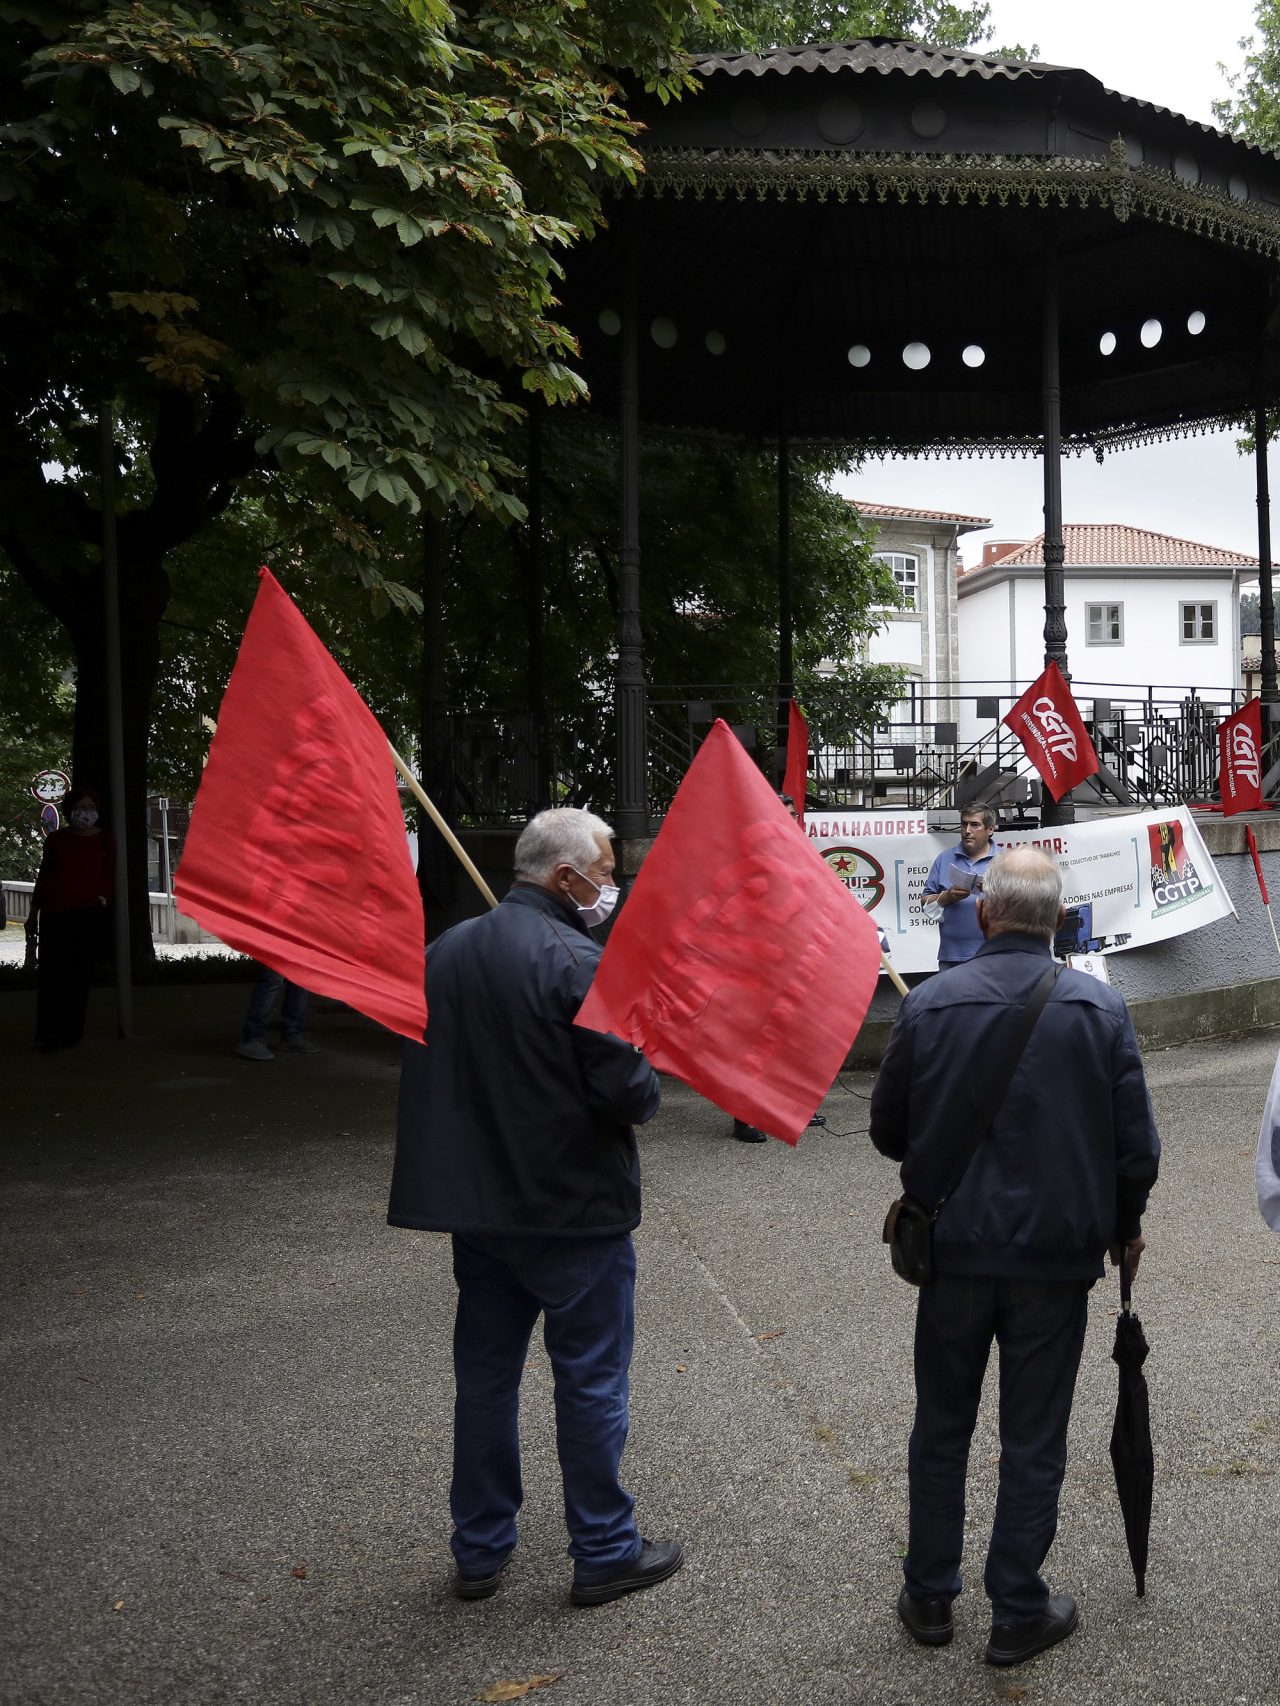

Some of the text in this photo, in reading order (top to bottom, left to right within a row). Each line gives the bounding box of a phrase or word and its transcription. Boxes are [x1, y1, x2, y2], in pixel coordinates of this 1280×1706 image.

[1033, 696, 1078, 762] CGTP
[1021, 711, 1058, 779] INTERSINDICAL NACIONAL
[1233, 722, 1259, 788] CGTP
[803, 820, 925, 838] ABALHADORES
[1070, 856, 1093, 866] COLECTIVO
[907, 866, 929, 875] PELO
[1091, 890, 1104, 900] NAS
[1104, 883, 1134, 897] EMPRESAS
[1155, 877, 1200, 905] CGTP
[909, 919, 920, 927] 35
